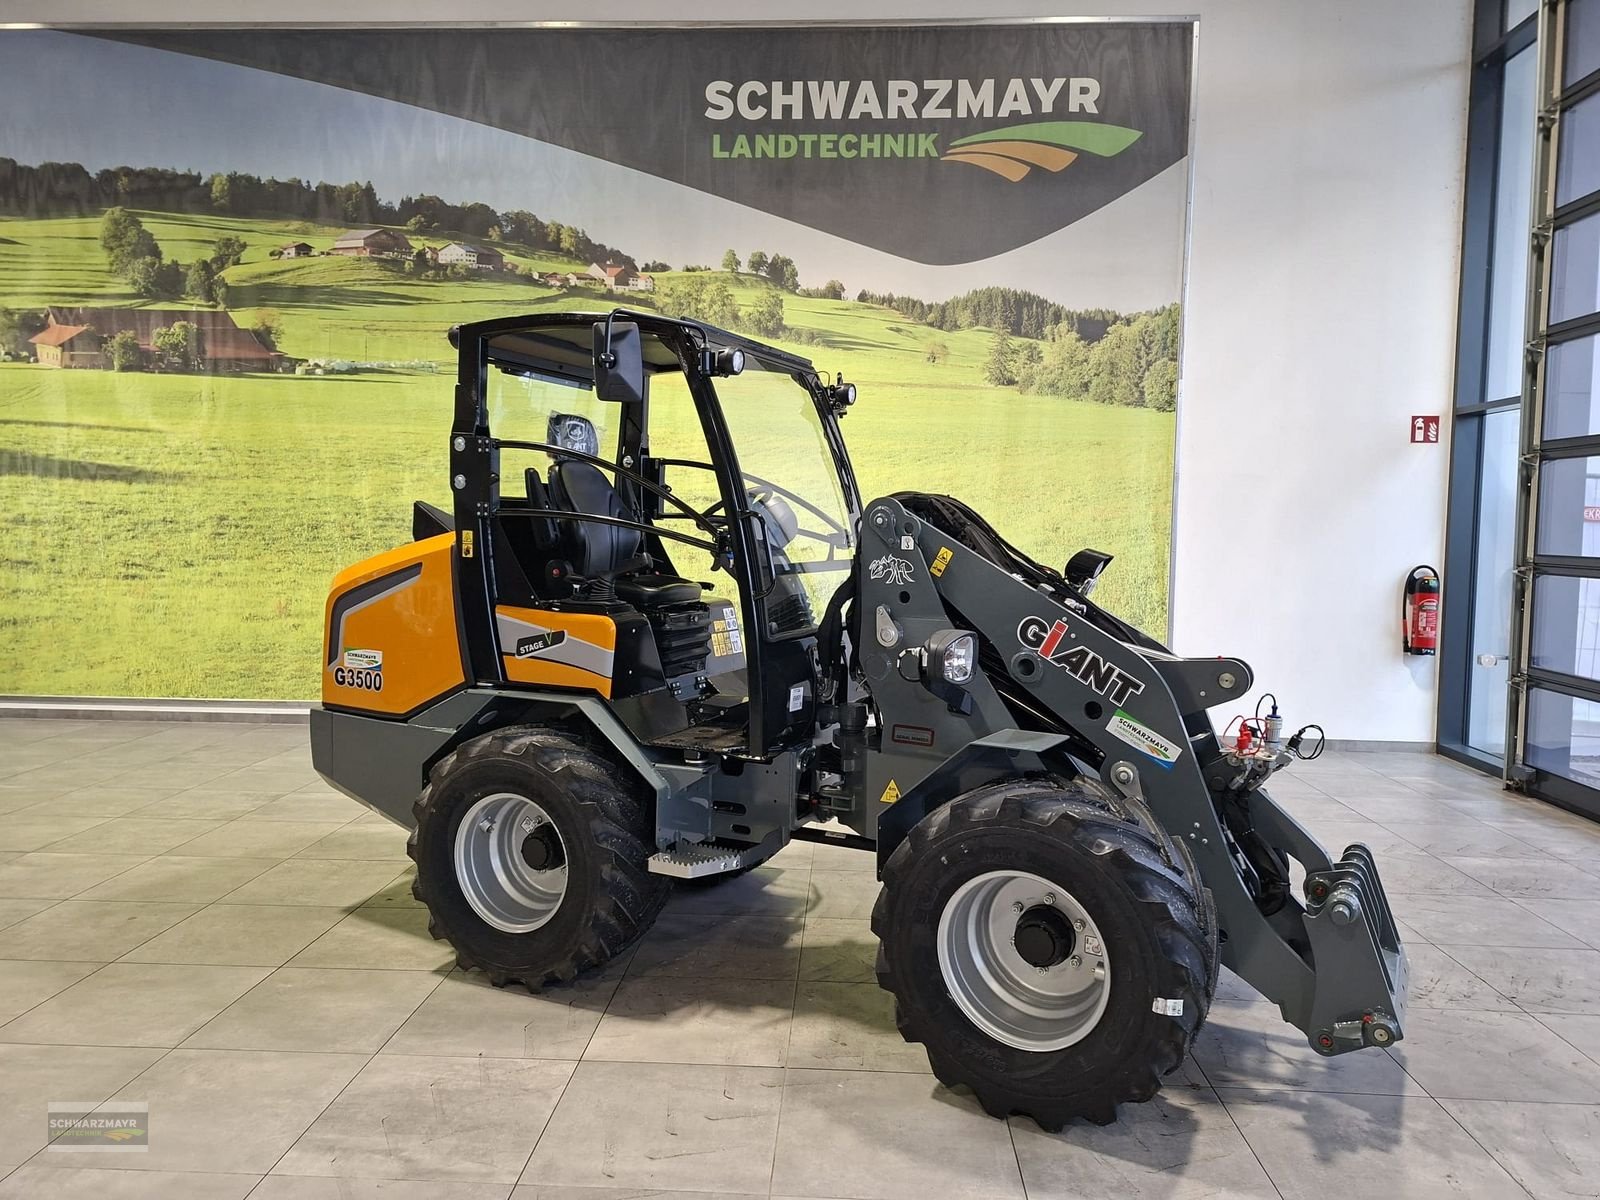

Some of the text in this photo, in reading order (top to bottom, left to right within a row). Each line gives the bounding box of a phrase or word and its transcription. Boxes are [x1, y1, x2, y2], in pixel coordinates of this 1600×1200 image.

[704, 78, 1101, 120] SCHWARZMAYR
[712, 133, 939, 159] LANDTECHNIK
[520, 640, 545, 654] STAGE
[1017, 616, 1146, 707] GIANT
[334, 667, 383, 692] G3500
[1118, 718, 1169, 753] SCHWARZMAYR
